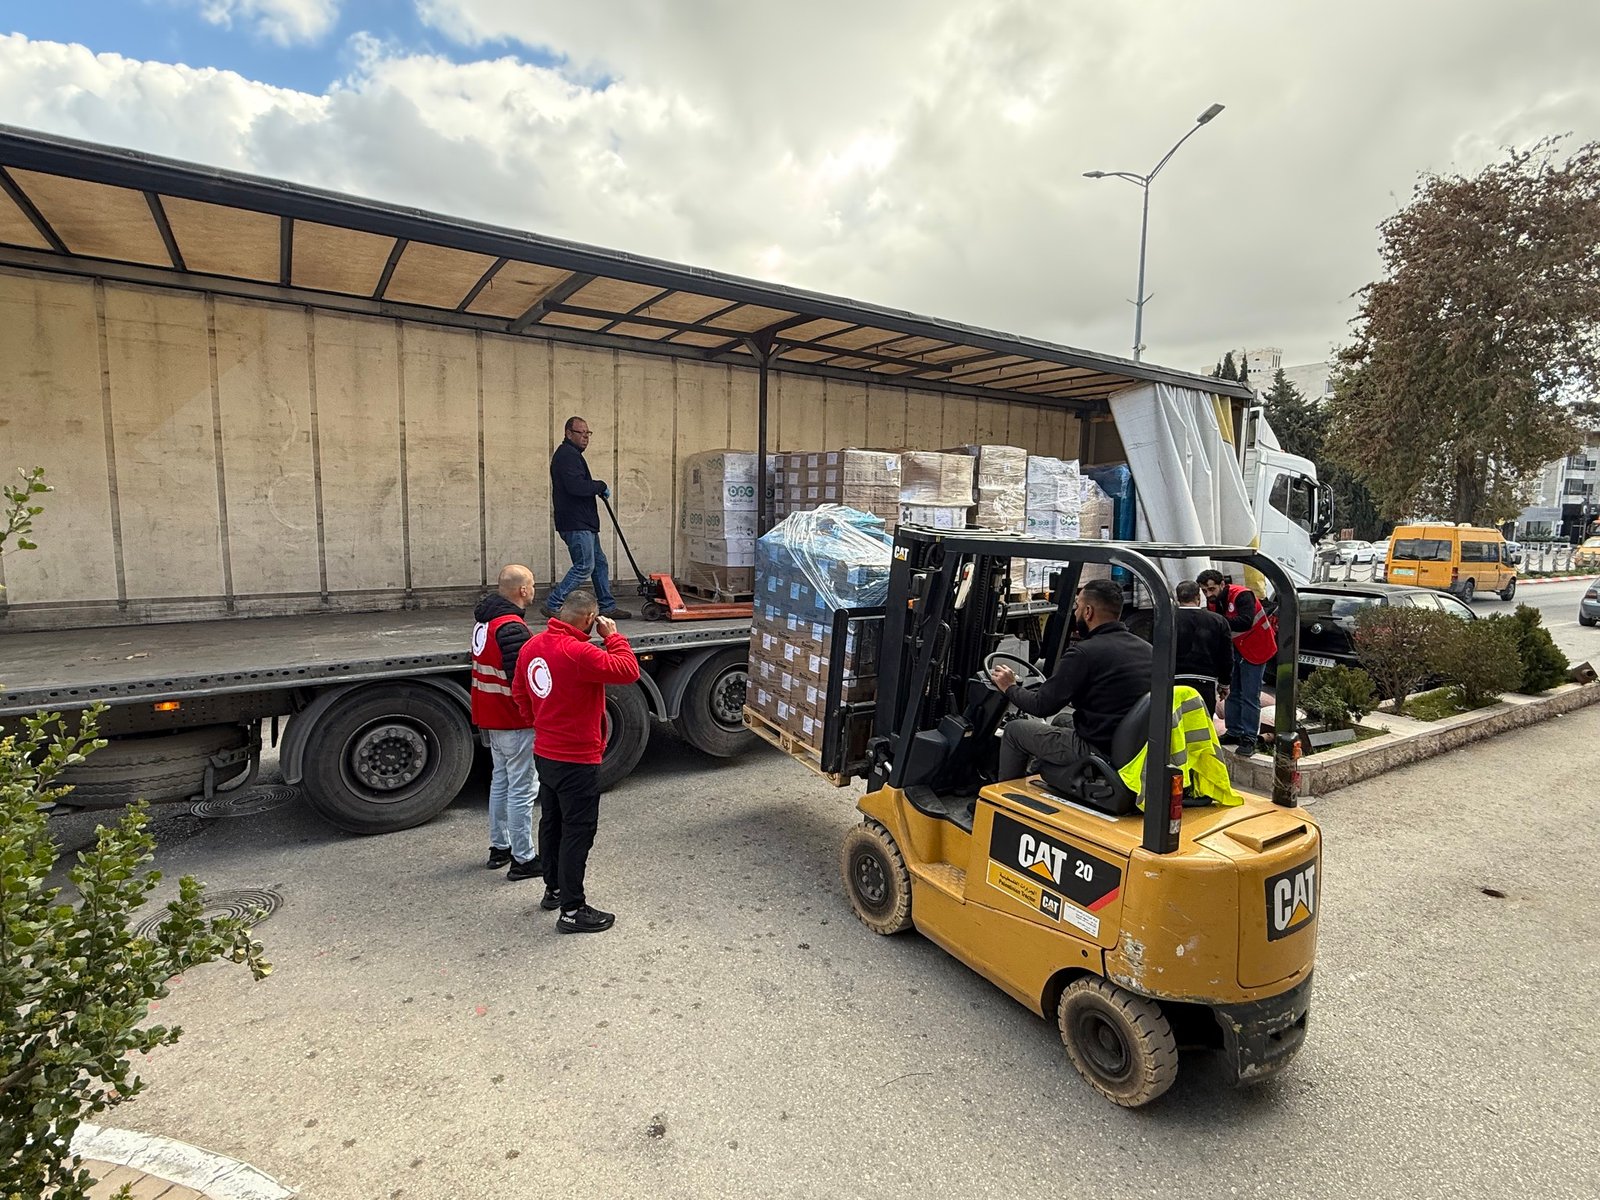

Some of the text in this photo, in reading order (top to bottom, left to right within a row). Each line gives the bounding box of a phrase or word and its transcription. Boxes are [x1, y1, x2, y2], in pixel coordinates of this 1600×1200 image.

[894, 545, 910, 561] CAT
[1018, 833, 1067, 885] CAT
[1075, 860, 1094, 882] 20
[1042, 895, 1059, 914] CAT
[1274, 864, 1315, 931] CAT
